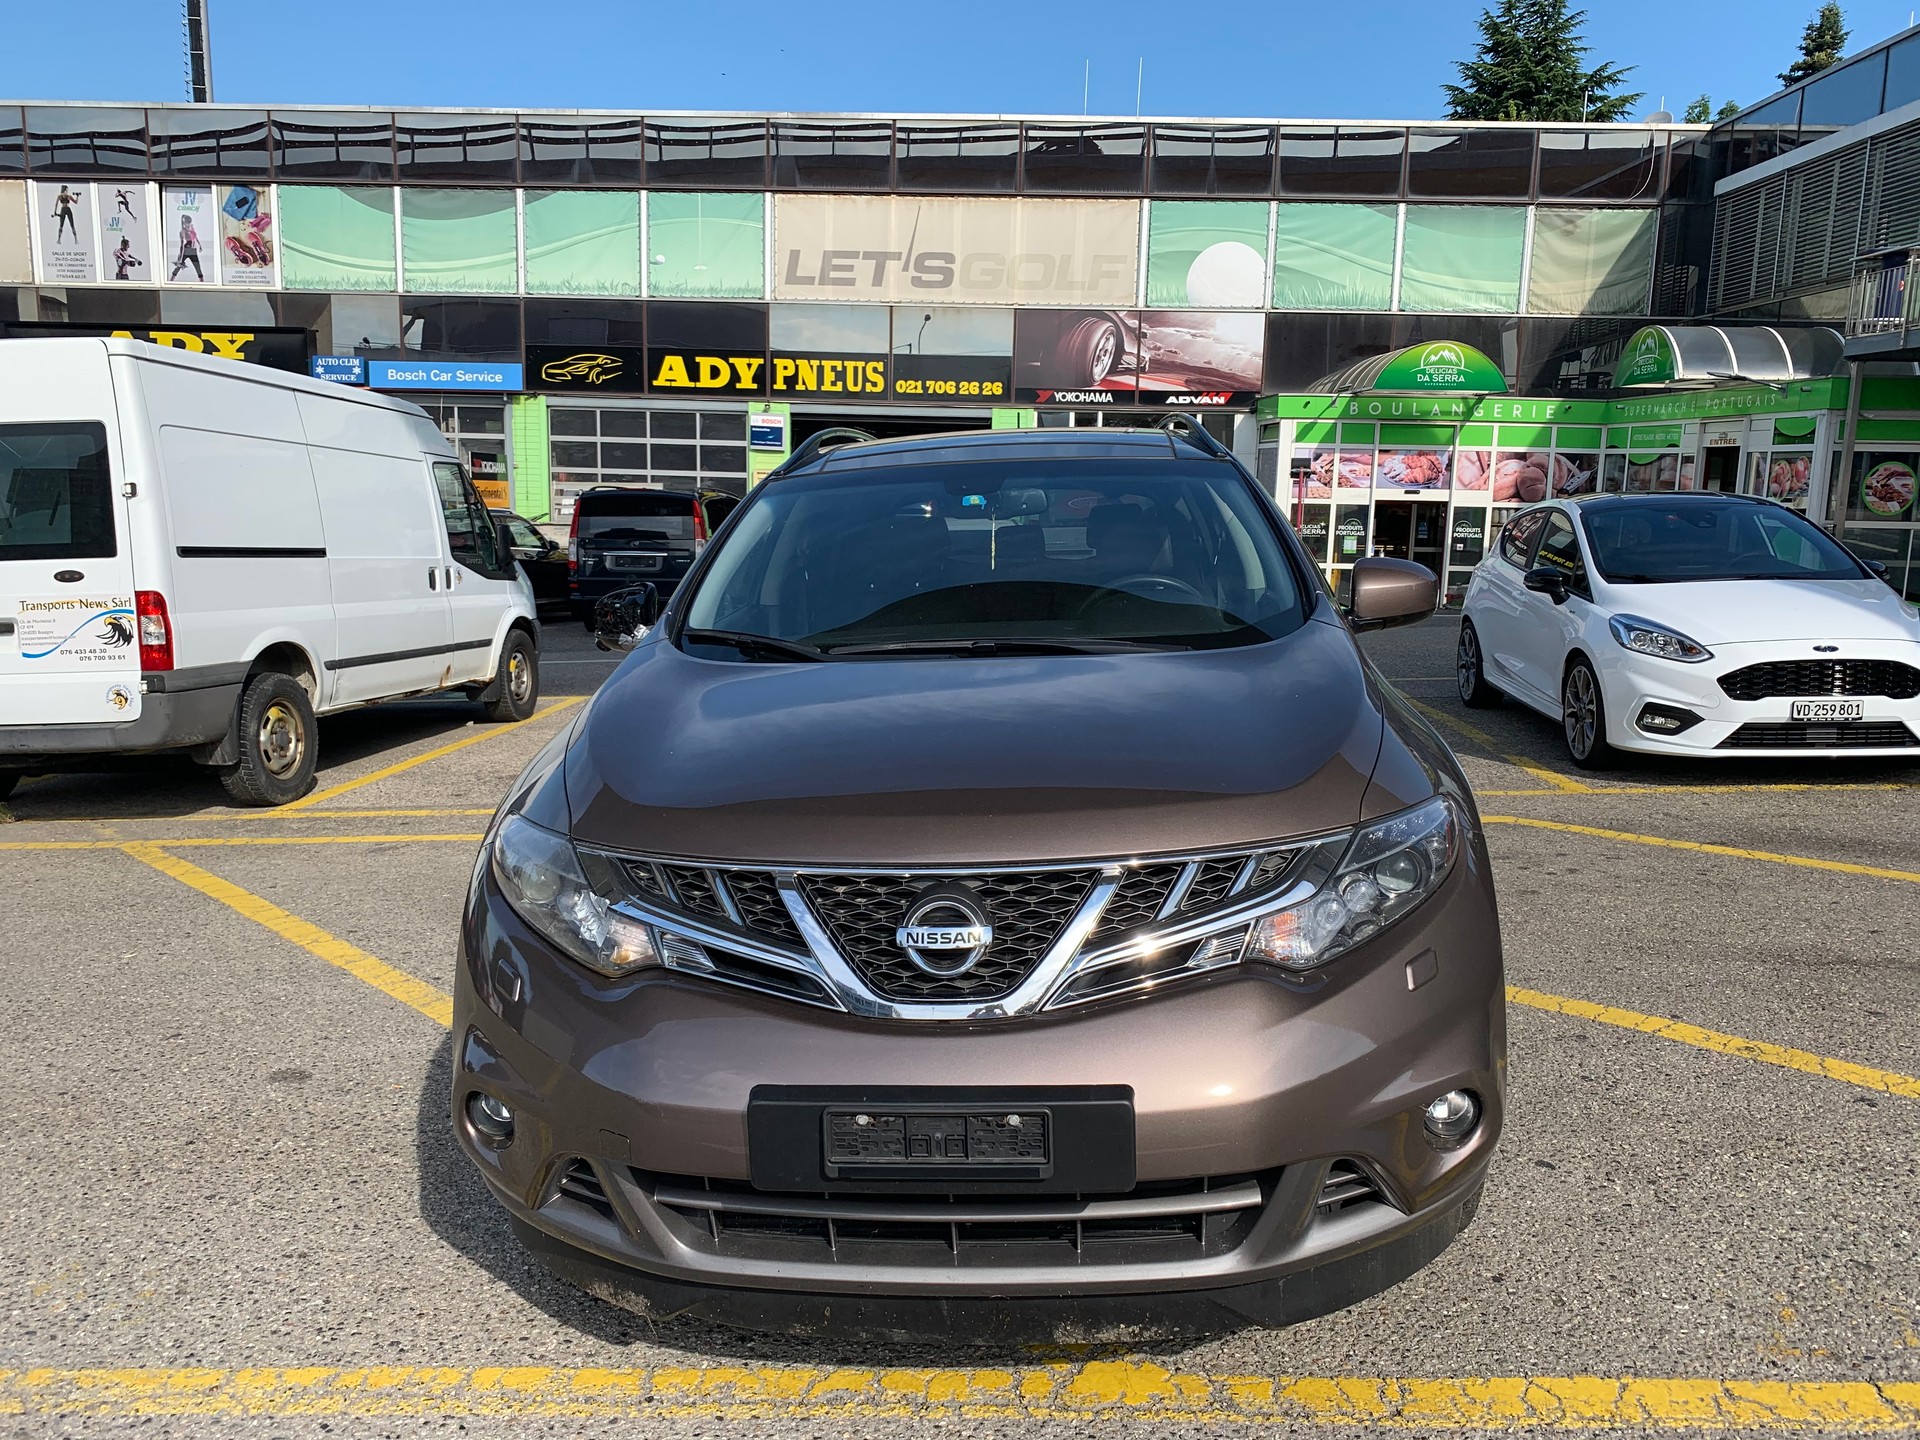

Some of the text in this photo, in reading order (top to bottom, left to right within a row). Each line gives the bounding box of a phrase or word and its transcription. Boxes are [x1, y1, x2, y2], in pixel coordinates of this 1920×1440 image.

[181, 191, 197, 205] JV
[109, 216, 120, 227] JV
[110, 330, 255, 360] DY
[317, 358, 360, 366] AUTO CLIM
[320, 373, 357, 381] SERVICE
[387, 369, 503, 383] Bosch Car Service
[652, 355, 885, 393] ADY PNEUS
[1425, 367, 1458, 375] DELICIAS
[1417, 374, 1465, 383] DA SERRA
[896, 380, 1003, 396] 021 706 26 26
[1054, 391, 1114, 403] YOKOHAMA
[1165, 395, 1225, 404] ADVAN
[1705, 394, 1777, 411] PORTUGAIS
[1350, 401, 1556, 419] BOULANGERIE
[19, 600, 75, 613] Transports
[78, 599, 108, 609] News
[906, 931, 981, 944] NISSAN
